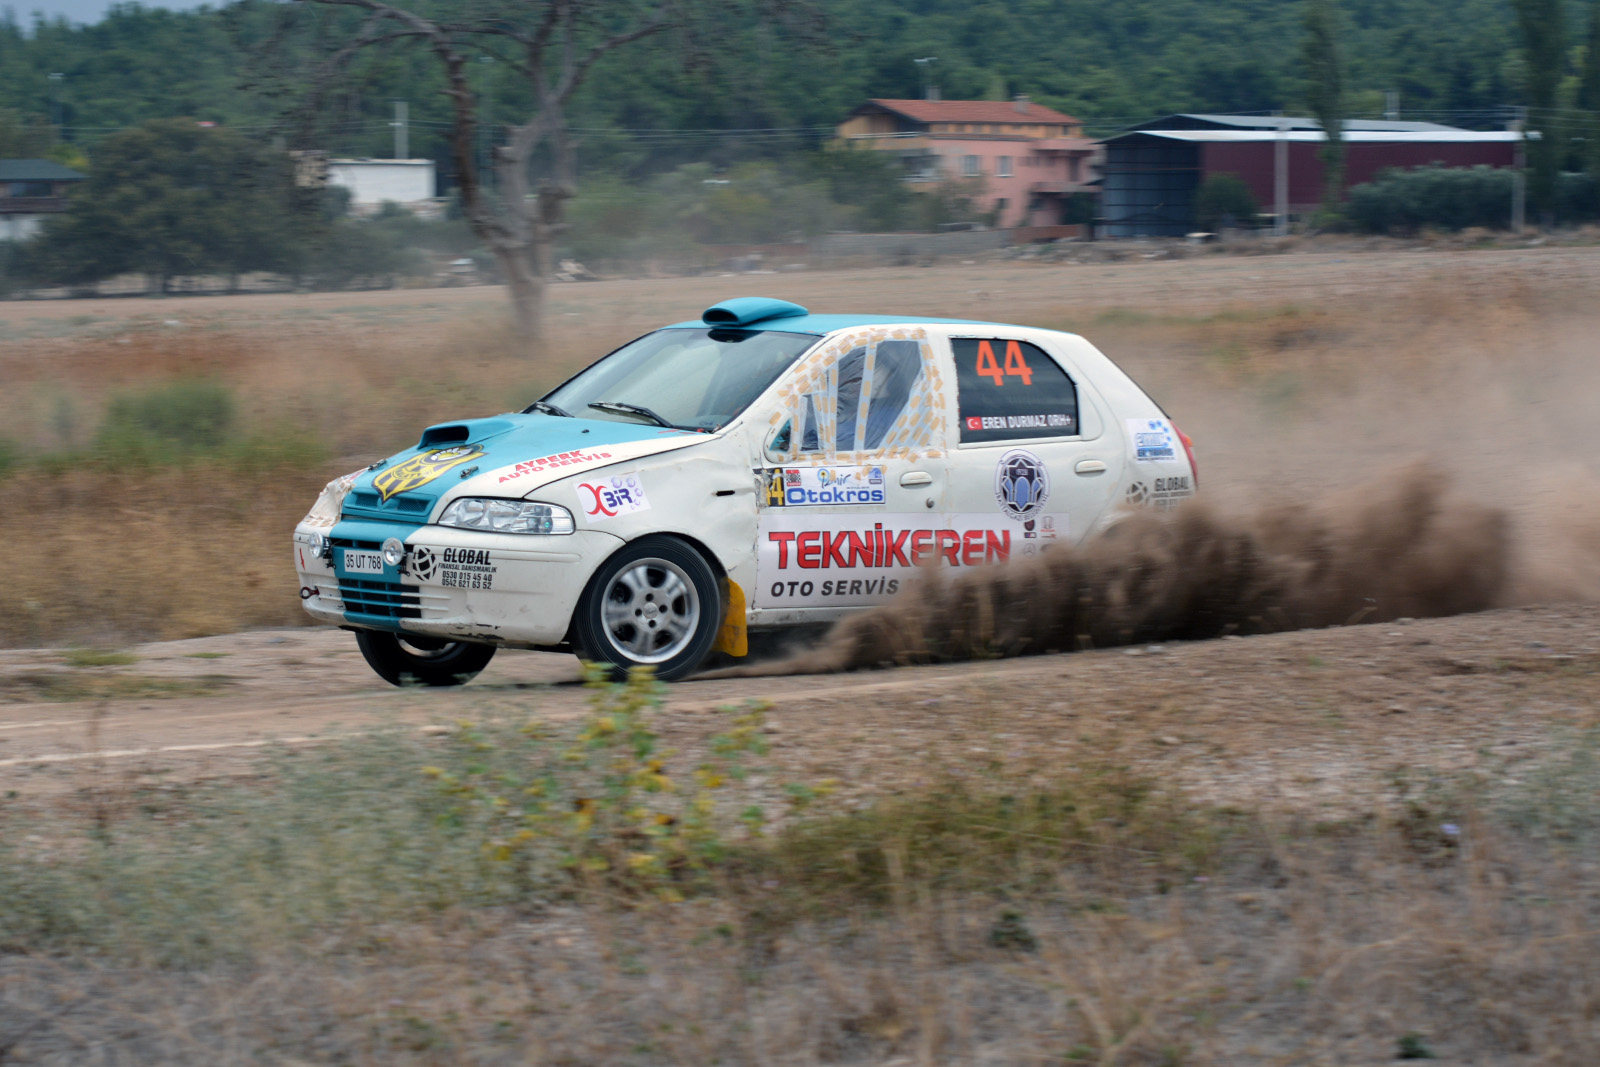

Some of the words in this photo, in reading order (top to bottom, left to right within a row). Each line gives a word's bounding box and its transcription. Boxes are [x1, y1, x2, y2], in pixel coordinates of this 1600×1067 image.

[976, 340, 1033, 386] 44
[981, 416, 1007, 429] EREN
[1007, 414, 1047, 428] DURMAZ
[515, 450, 585, 471] AYBERK
[498, 466, 544, 483] AUTO
[786, 487, 883, 504] Otokros
[345, 554, 354, 568] 35
[355, 555, 366, 568] UT
[367, 556, 381, 569] 768
[443, 547, 491, 565] GLOBAL
[441, 578, 457, 587] 0542
[458, 579, 470, 588] 621
[472, 580, 481, 589] 63
[482, 581, 492, 590] 52
[442, 570, 457, 580] 0530
[459, 571, 471, 581] 015
[472, 572, 482, 581] 45
[483, 573, 493, 582] 40
[771, 581, 814, 597] OTO
